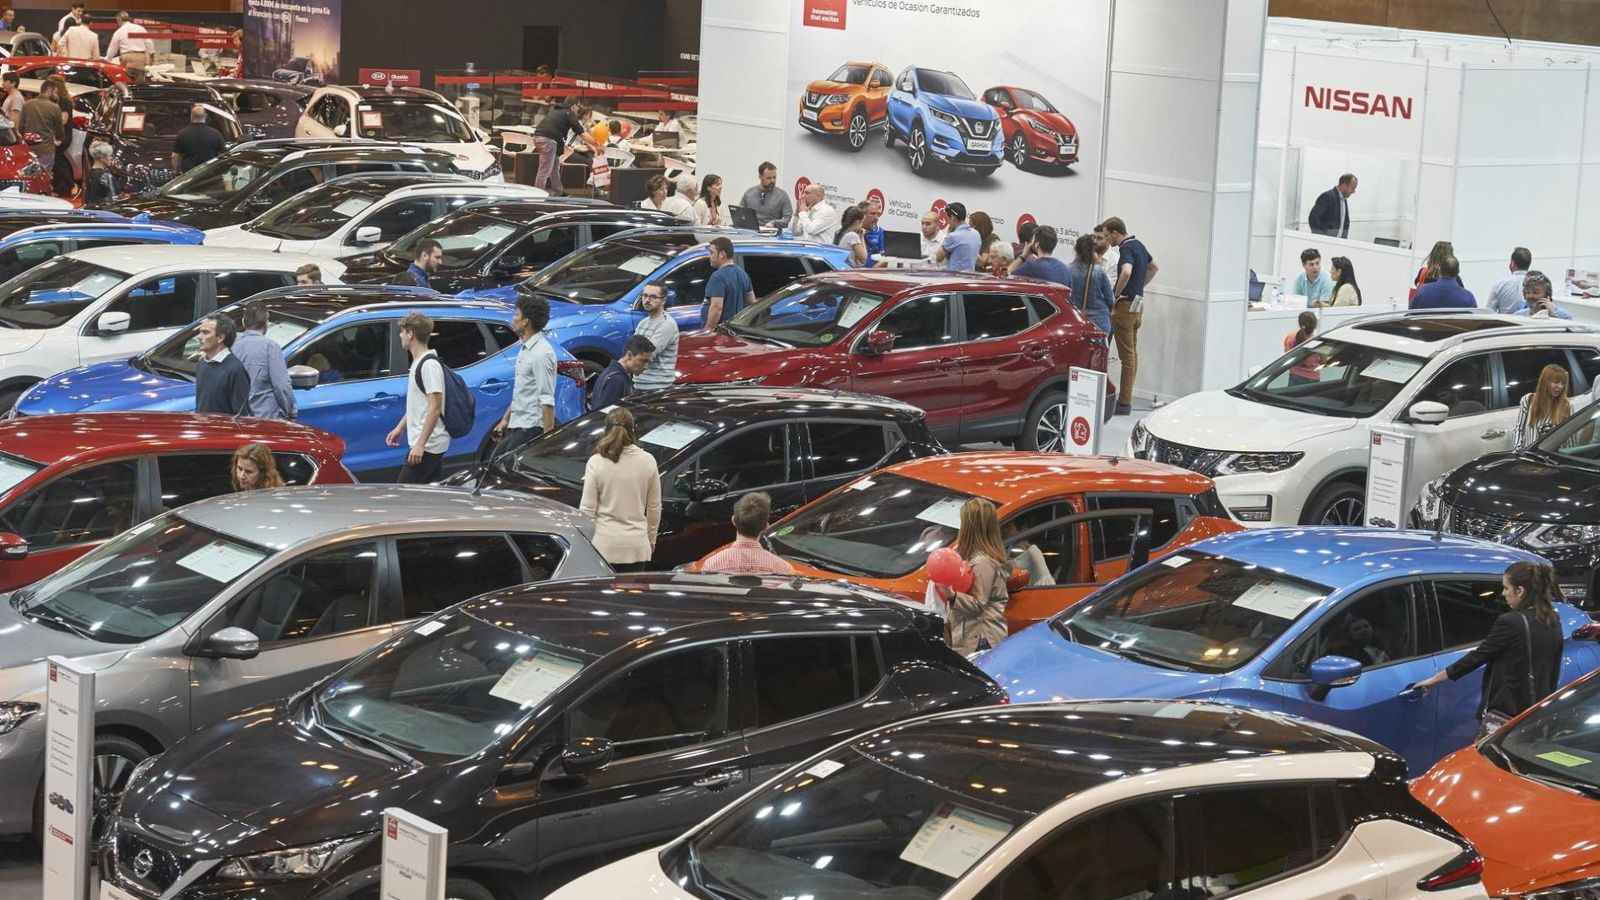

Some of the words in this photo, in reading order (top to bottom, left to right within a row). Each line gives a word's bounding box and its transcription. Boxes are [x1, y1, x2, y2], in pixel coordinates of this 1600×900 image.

[888, 0, 898, 9] de
[930, 4, 980, 18] Garantizados
[1304, 85, 1413, 120] NISSAN
[888, 207, 895, 215] de
